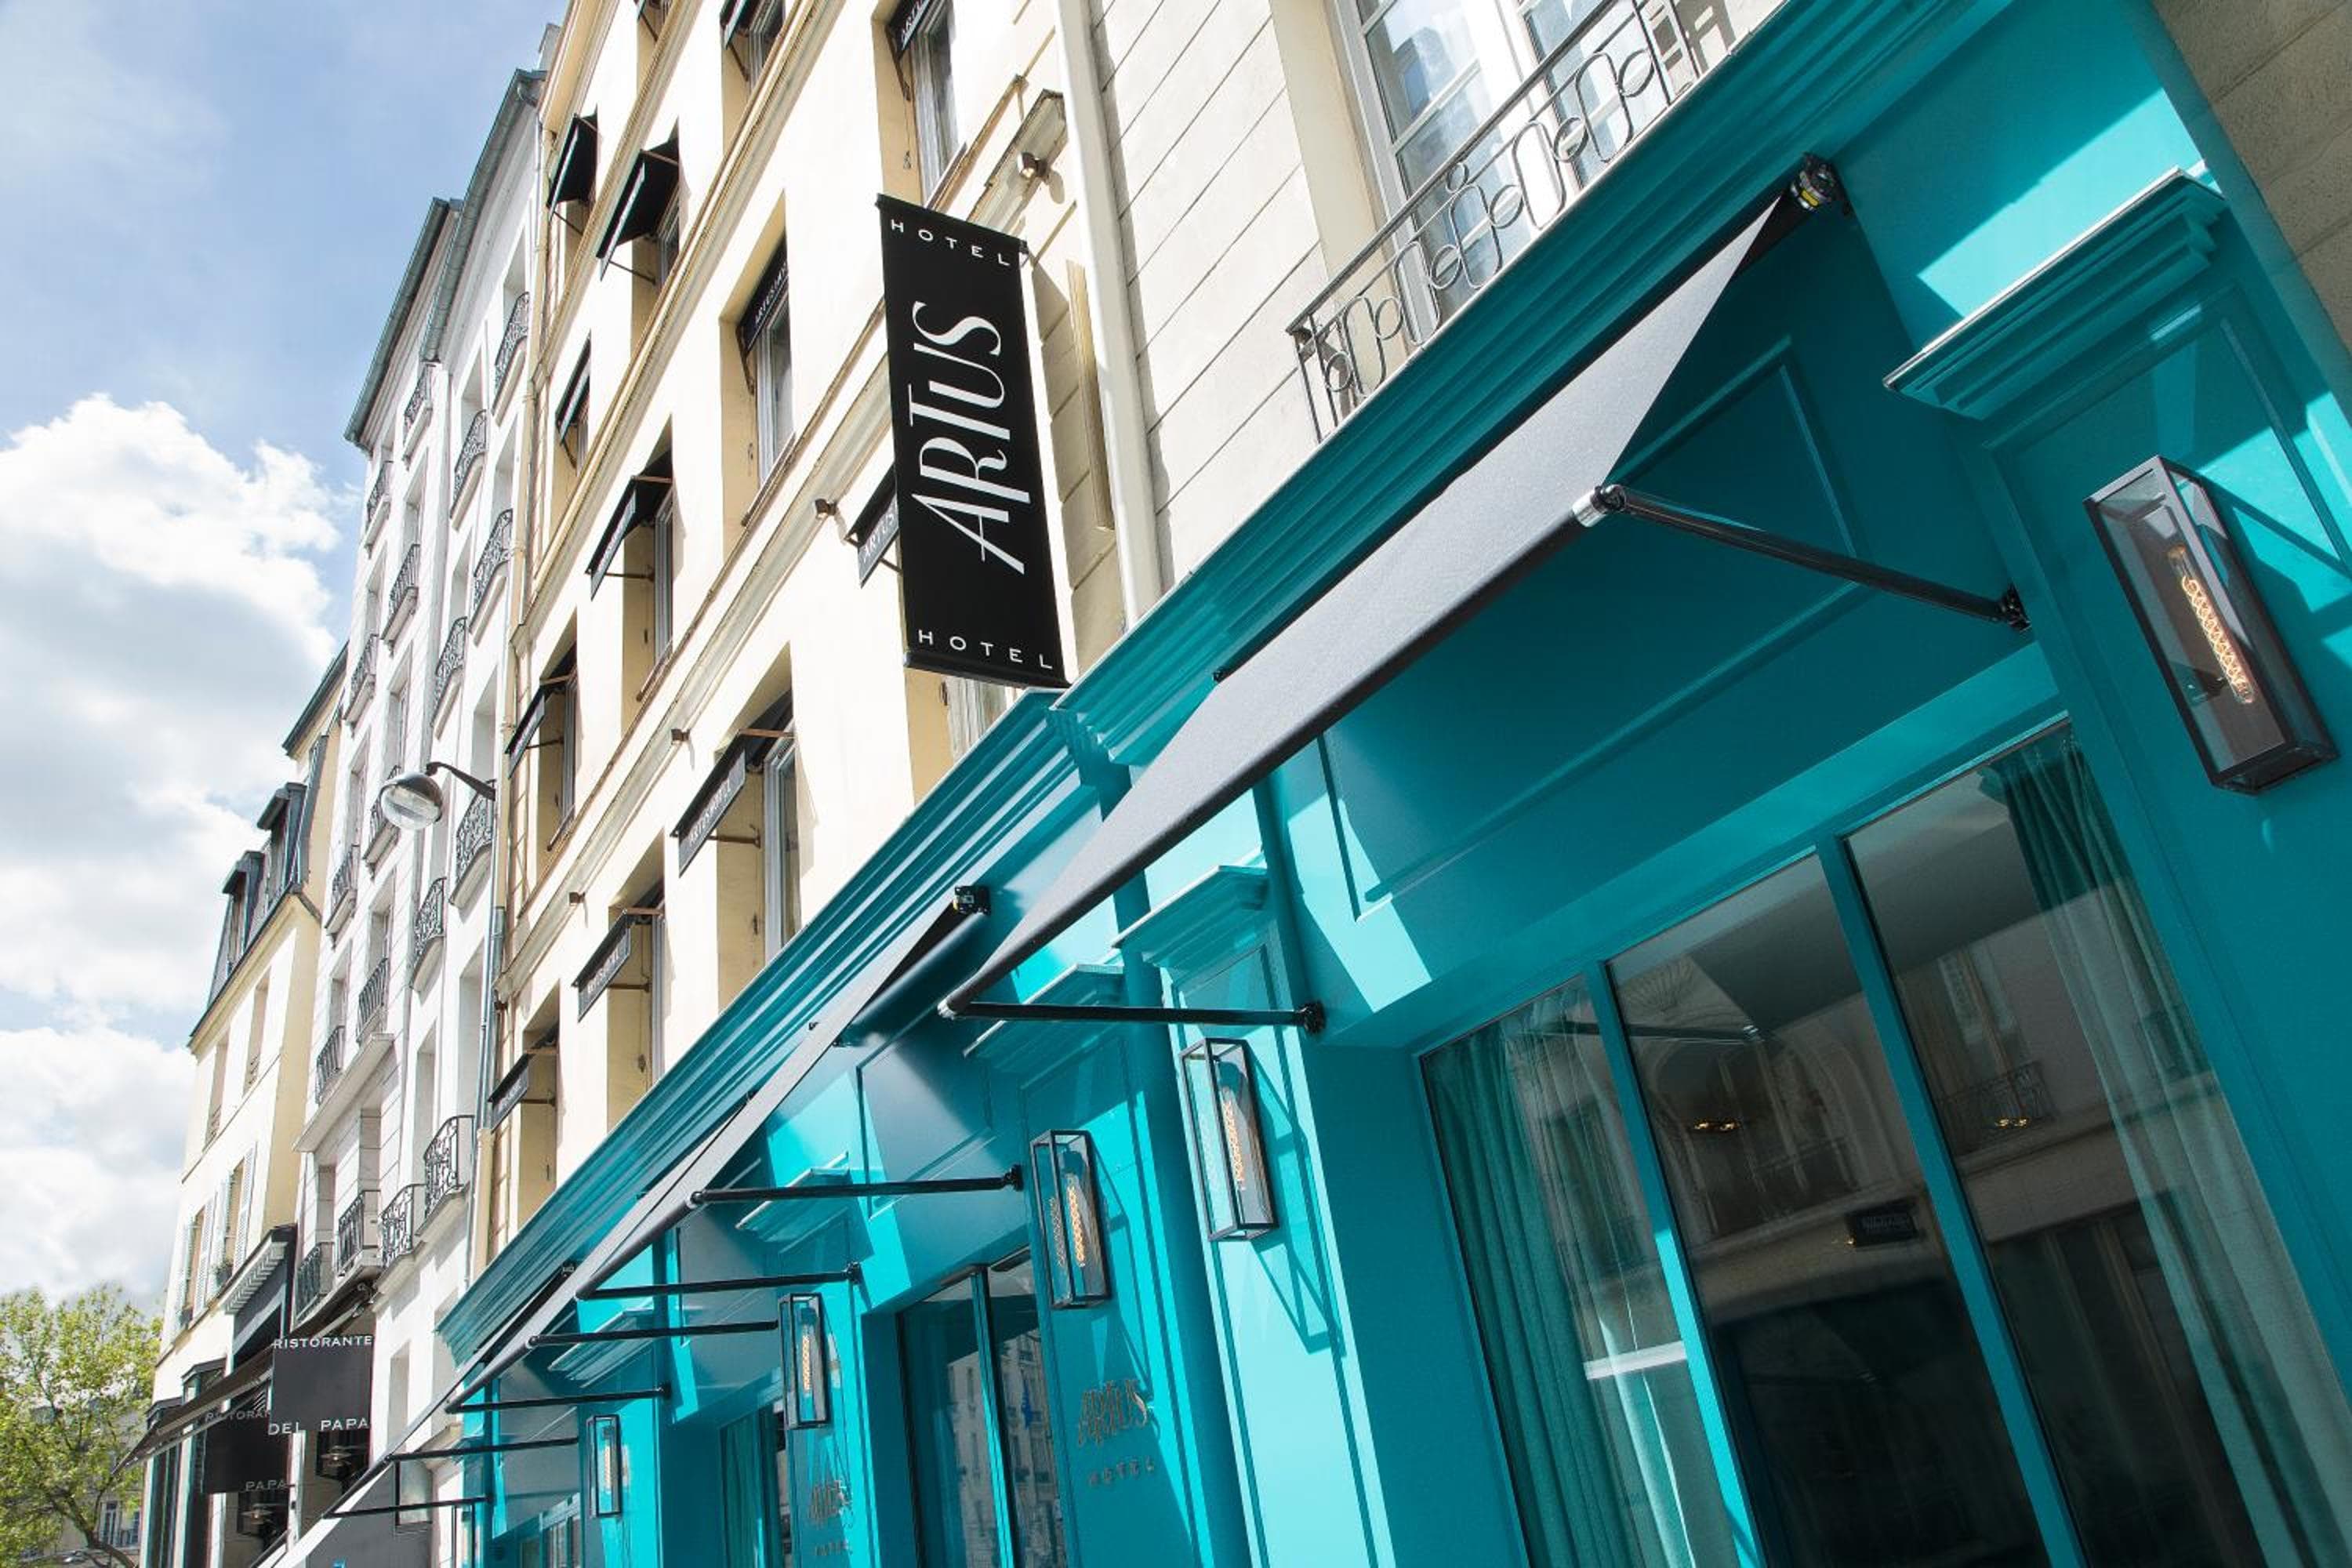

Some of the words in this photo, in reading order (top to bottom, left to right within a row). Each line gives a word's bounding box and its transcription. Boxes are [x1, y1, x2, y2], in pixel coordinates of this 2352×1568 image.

[891, 219, 1010, 266] HOTEL
[909, 300, 1031, 575] ARTUS
[918, 629, 1053, 670] HOTEL
[274, 1334, 373, 1349] RISTORANTE
[268, 1421, 304, 1436] DEL
[320, 1417, 368, 1432] PAPA
